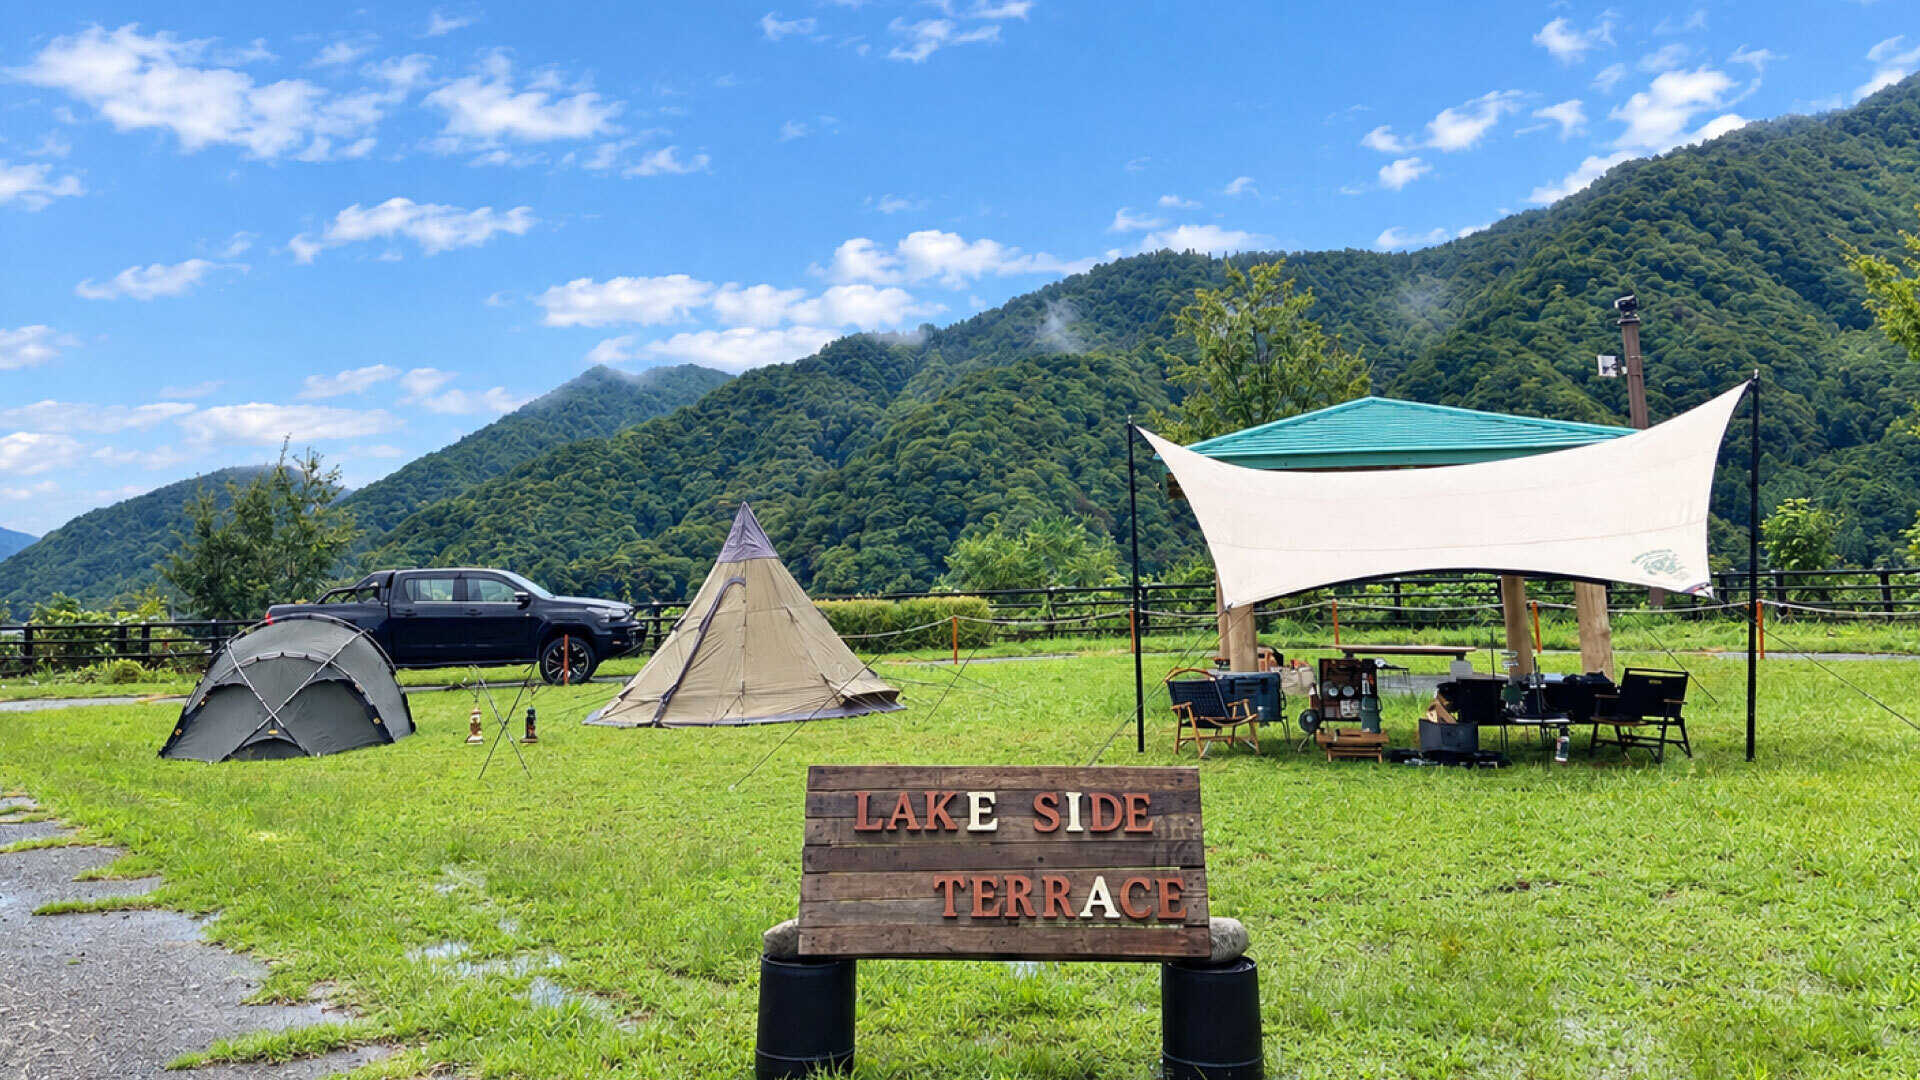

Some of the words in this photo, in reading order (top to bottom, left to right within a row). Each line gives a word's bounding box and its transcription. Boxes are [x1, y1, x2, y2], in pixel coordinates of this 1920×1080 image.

[854, 791, 998, 832] LAKE
[1033, 791, 1153, 833] SIDE
[933, 875, 1187, 920] TERRACE
